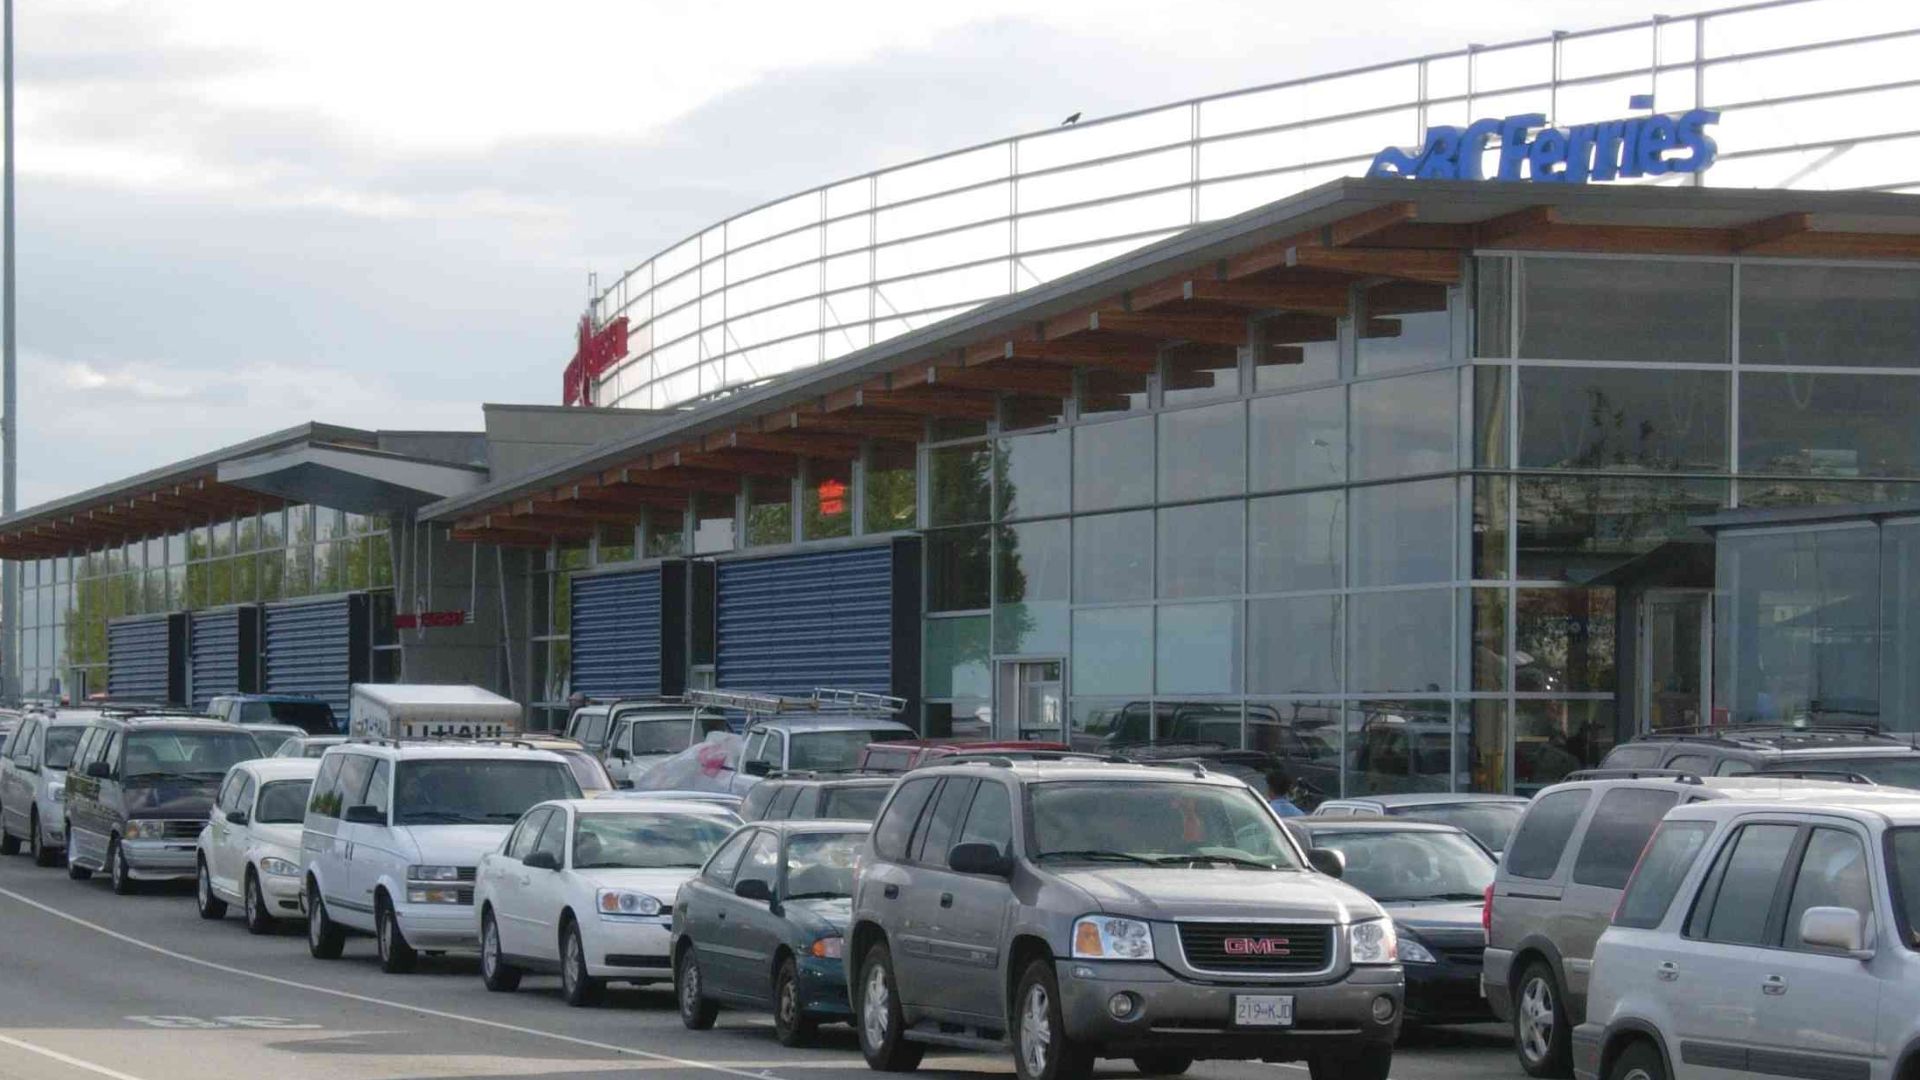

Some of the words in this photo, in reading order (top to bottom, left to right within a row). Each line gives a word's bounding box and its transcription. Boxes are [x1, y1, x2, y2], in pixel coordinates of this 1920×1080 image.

[1416, 118, 1503, 181] BC
[1497, 94, 1721, 184] Ferries
[1225, 938, 1290, 954] GMC
